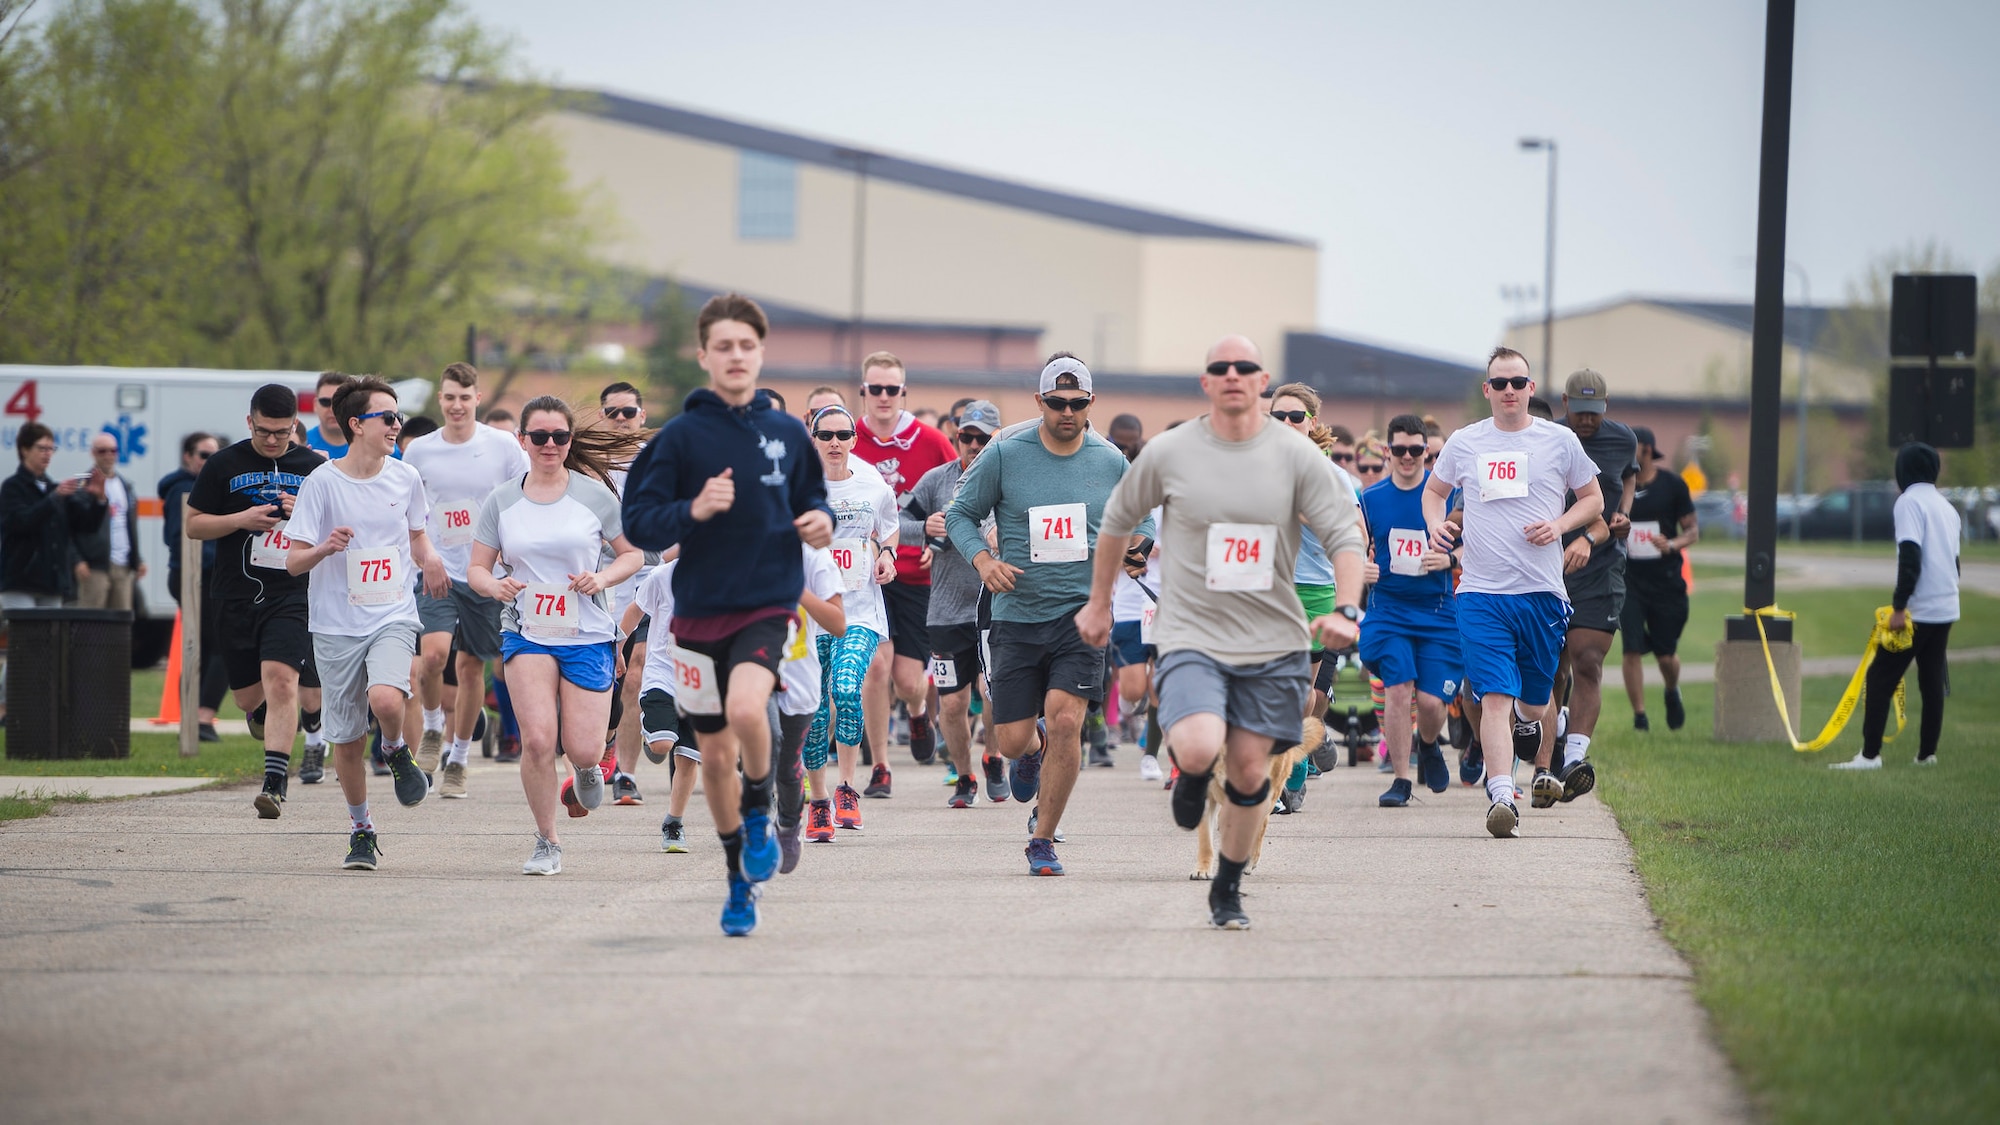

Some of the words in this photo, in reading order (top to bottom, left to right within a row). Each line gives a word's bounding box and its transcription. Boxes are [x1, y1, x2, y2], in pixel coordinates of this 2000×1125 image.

[4, 379, 43, 422] 4
[1487, 460, 1517, 481] 766
[444, 509, 471, 529] 788
[1042, 516, 1074, 540] 741
[829, 548, 852, 569] 50
[1223, 537, 1261, 563] 784
[1396, 538, 1423, 557] 743
[360, 558, 393, 583] 775
[535, 593, 566, 617] 774
